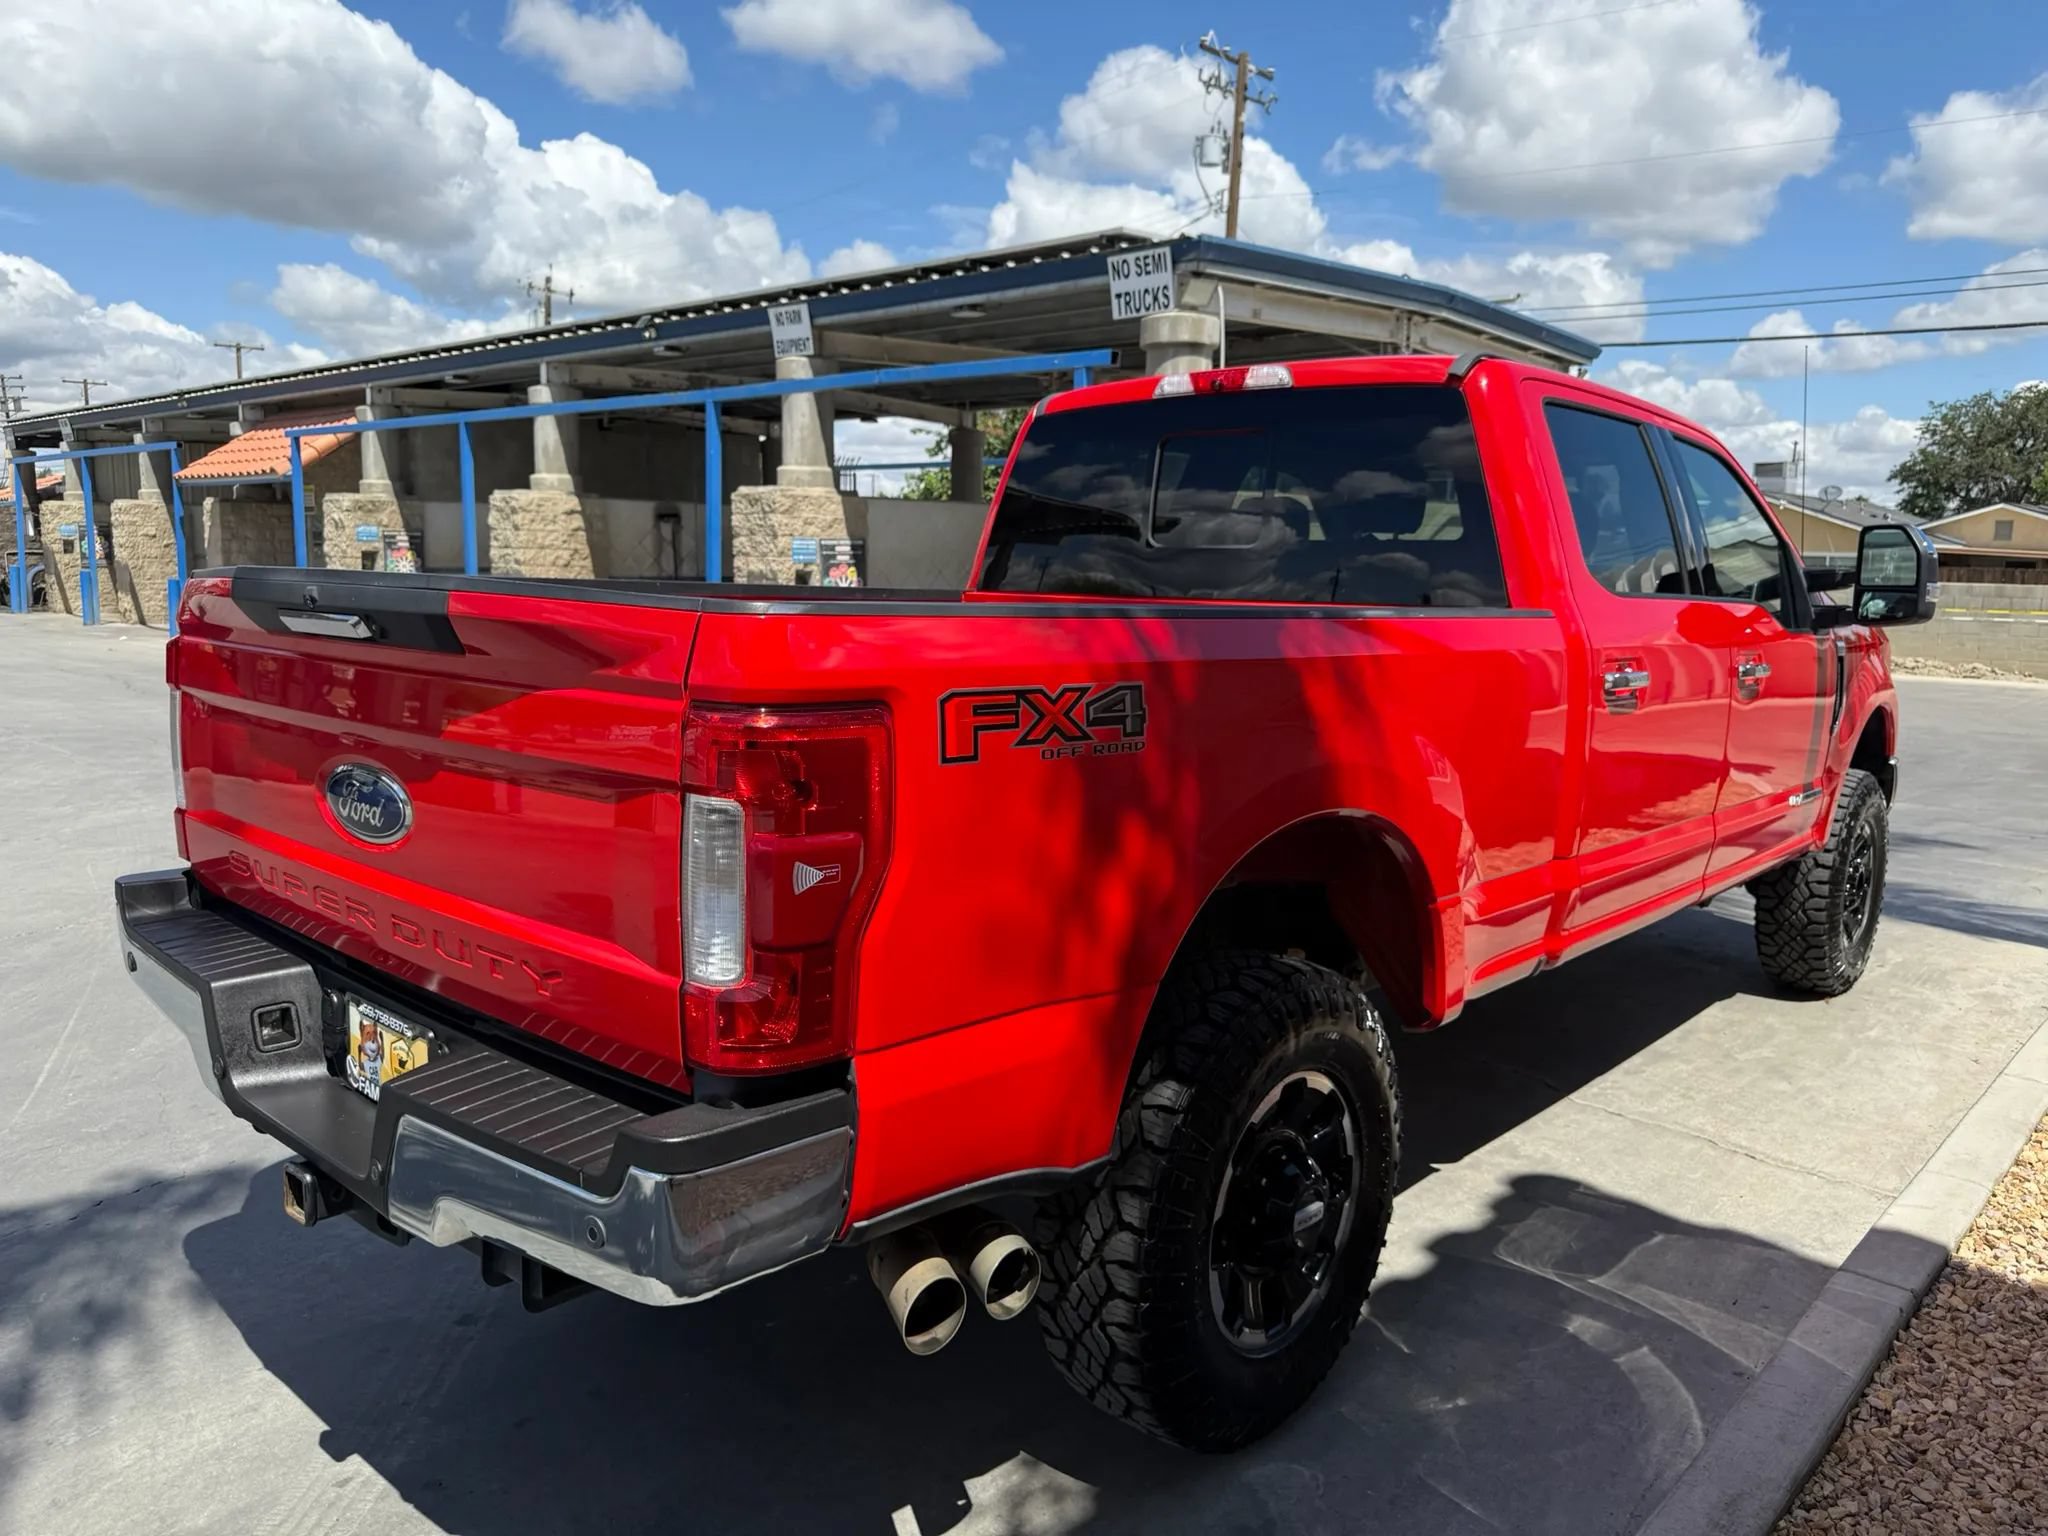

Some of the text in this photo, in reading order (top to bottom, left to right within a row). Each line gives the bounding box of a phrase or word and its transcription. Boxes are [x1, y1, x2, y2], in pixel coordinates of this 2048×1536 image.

[1111, 251, 1168, 281] NO SEMI
[1114, 285, 1170, 316] TRUCKS
[775, 311, 785, 326] NO
[776, 337, 810, 354] EQUIPMENT
[937, 681, 1149, 767] FX4
[1040, 740, 1147, 761] OFF ROAD
[338, 780, 385, 828] Ford
[227, 849, 565, 998] SUPER DUTY
